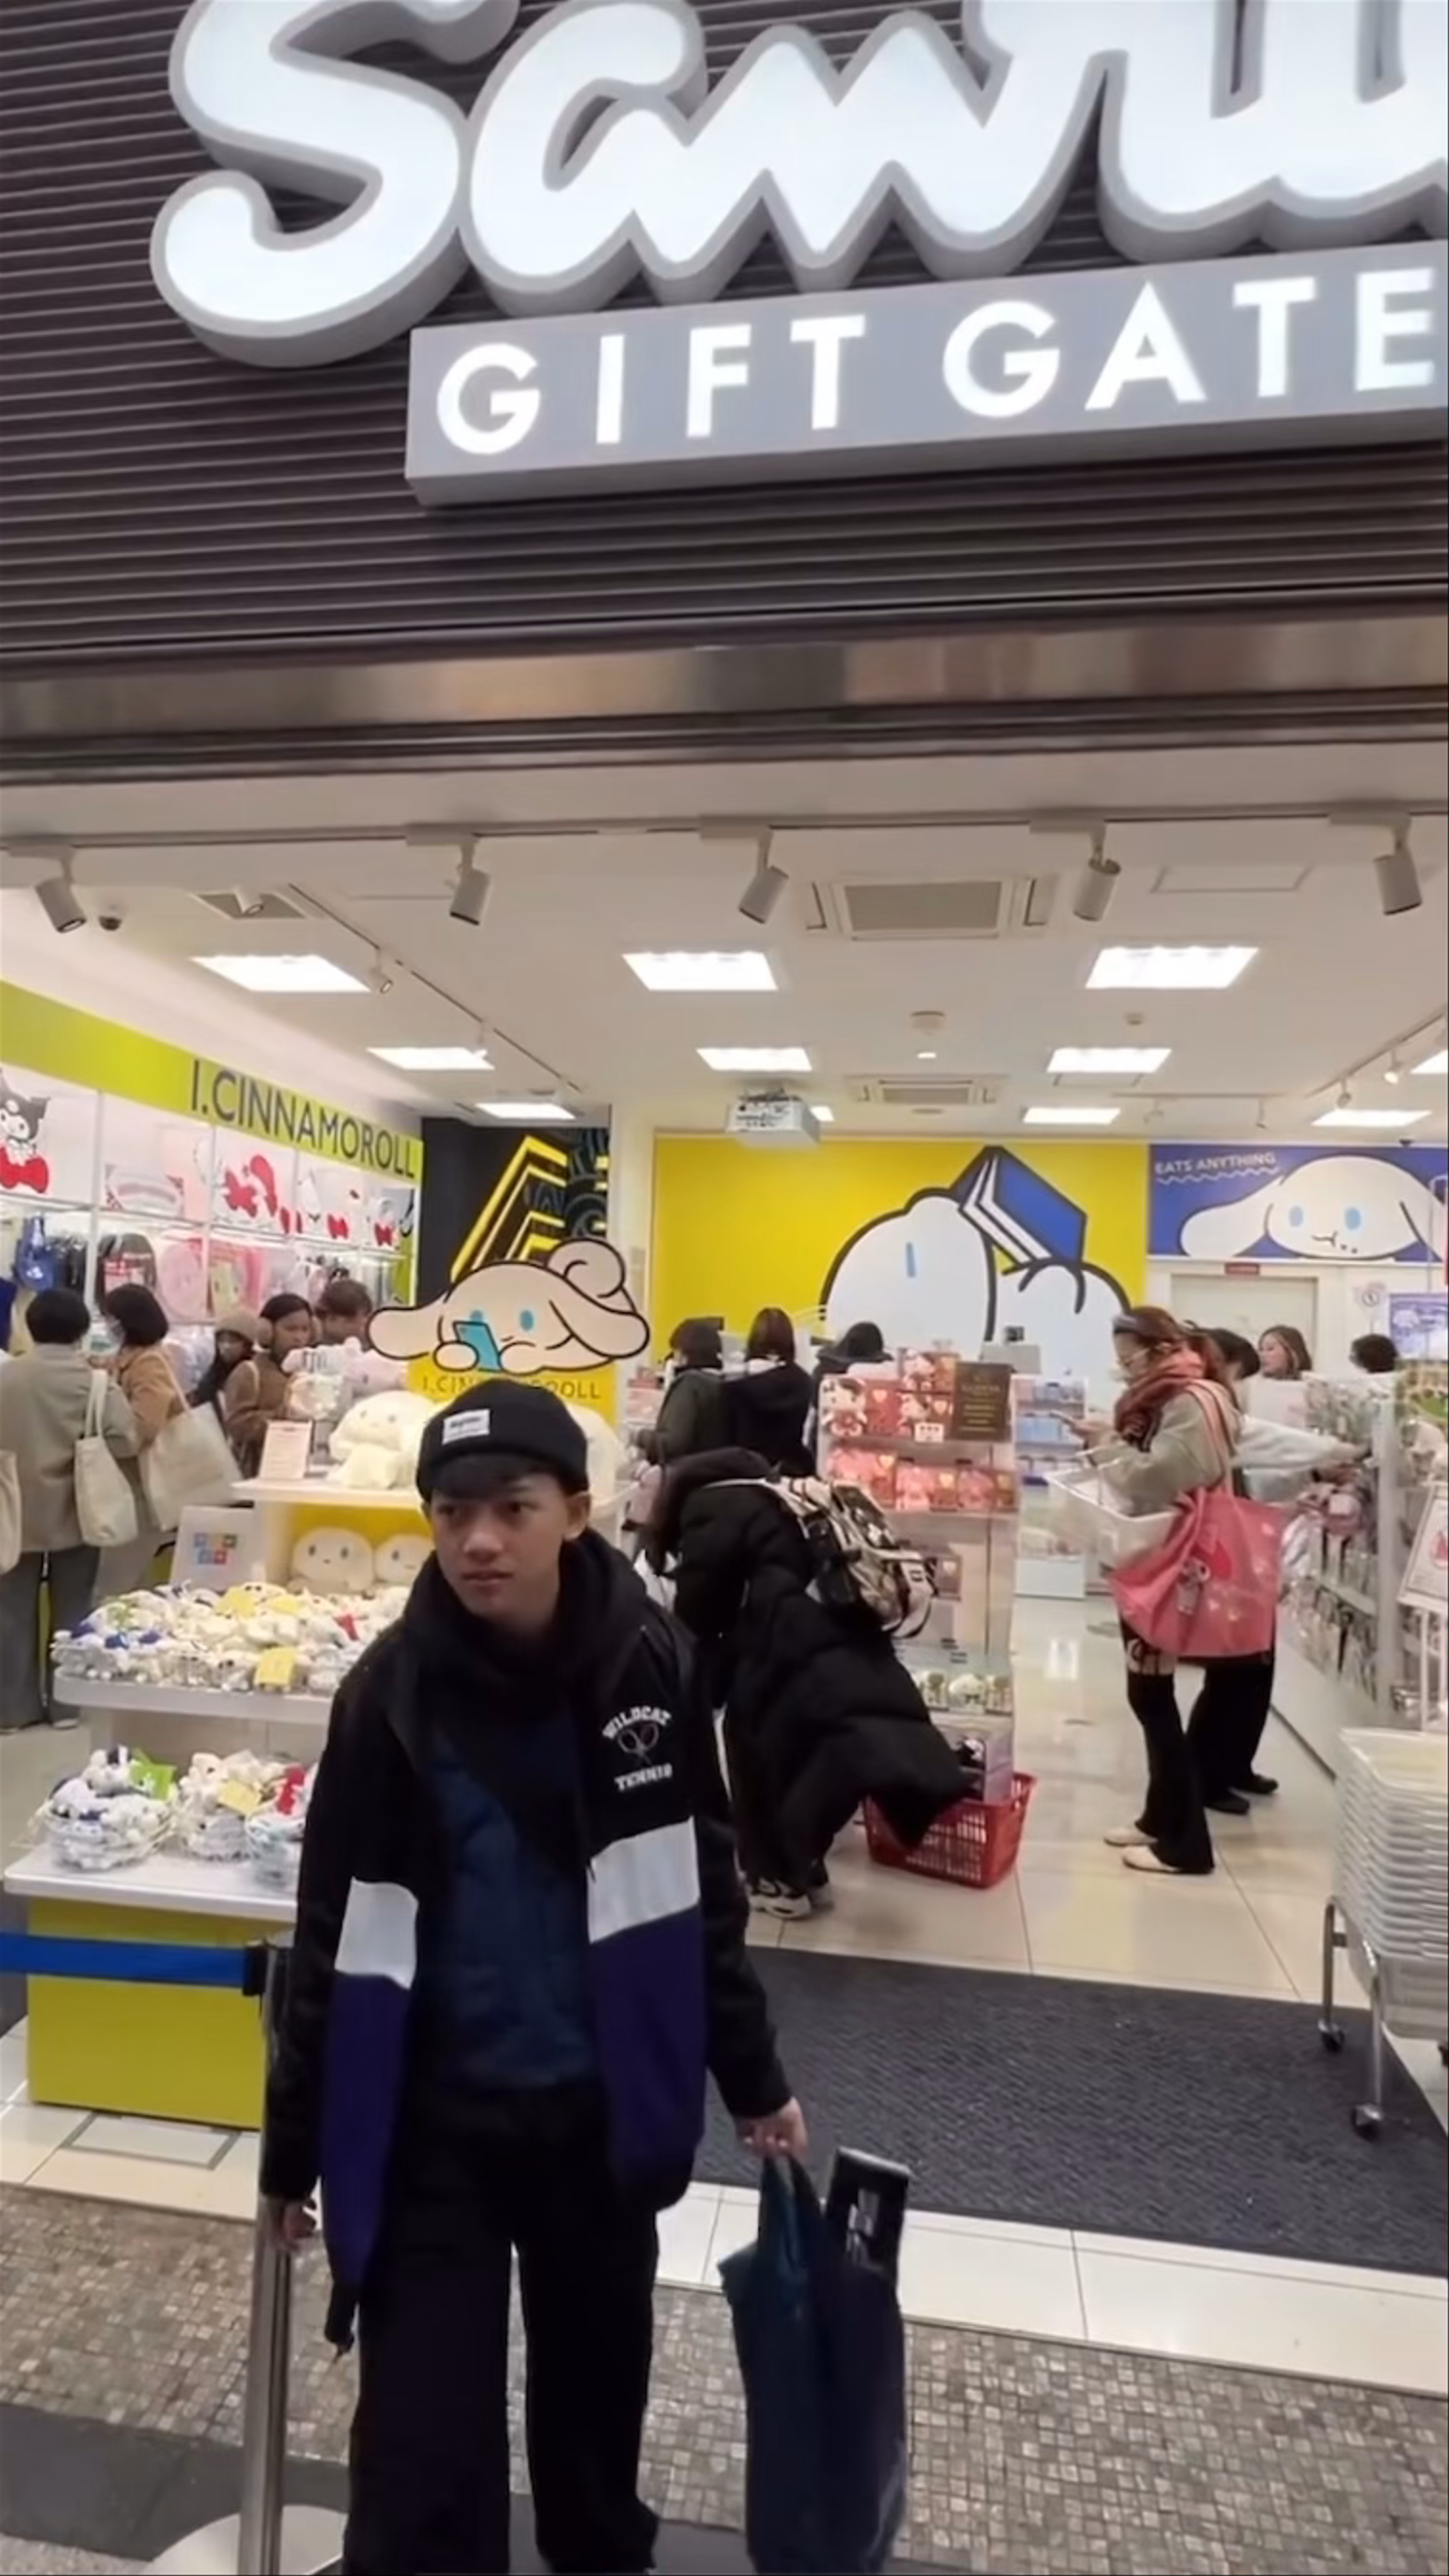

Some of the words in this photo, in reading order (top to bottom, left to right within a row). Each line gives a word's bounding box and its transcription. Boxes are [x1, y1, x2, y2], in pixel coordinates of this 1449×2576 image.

[437, 315, 866, 454] GIFT
[943, 268, 1434, 417] GATE
[192, 1060, 414, 1179] I.CINNAMOROLL
[1156, 1160, 1192, 1174] EATS
[1197, 1152, 1275, 1170] ANYTHING
[614, 1762, 672, 1790] TENNIS
